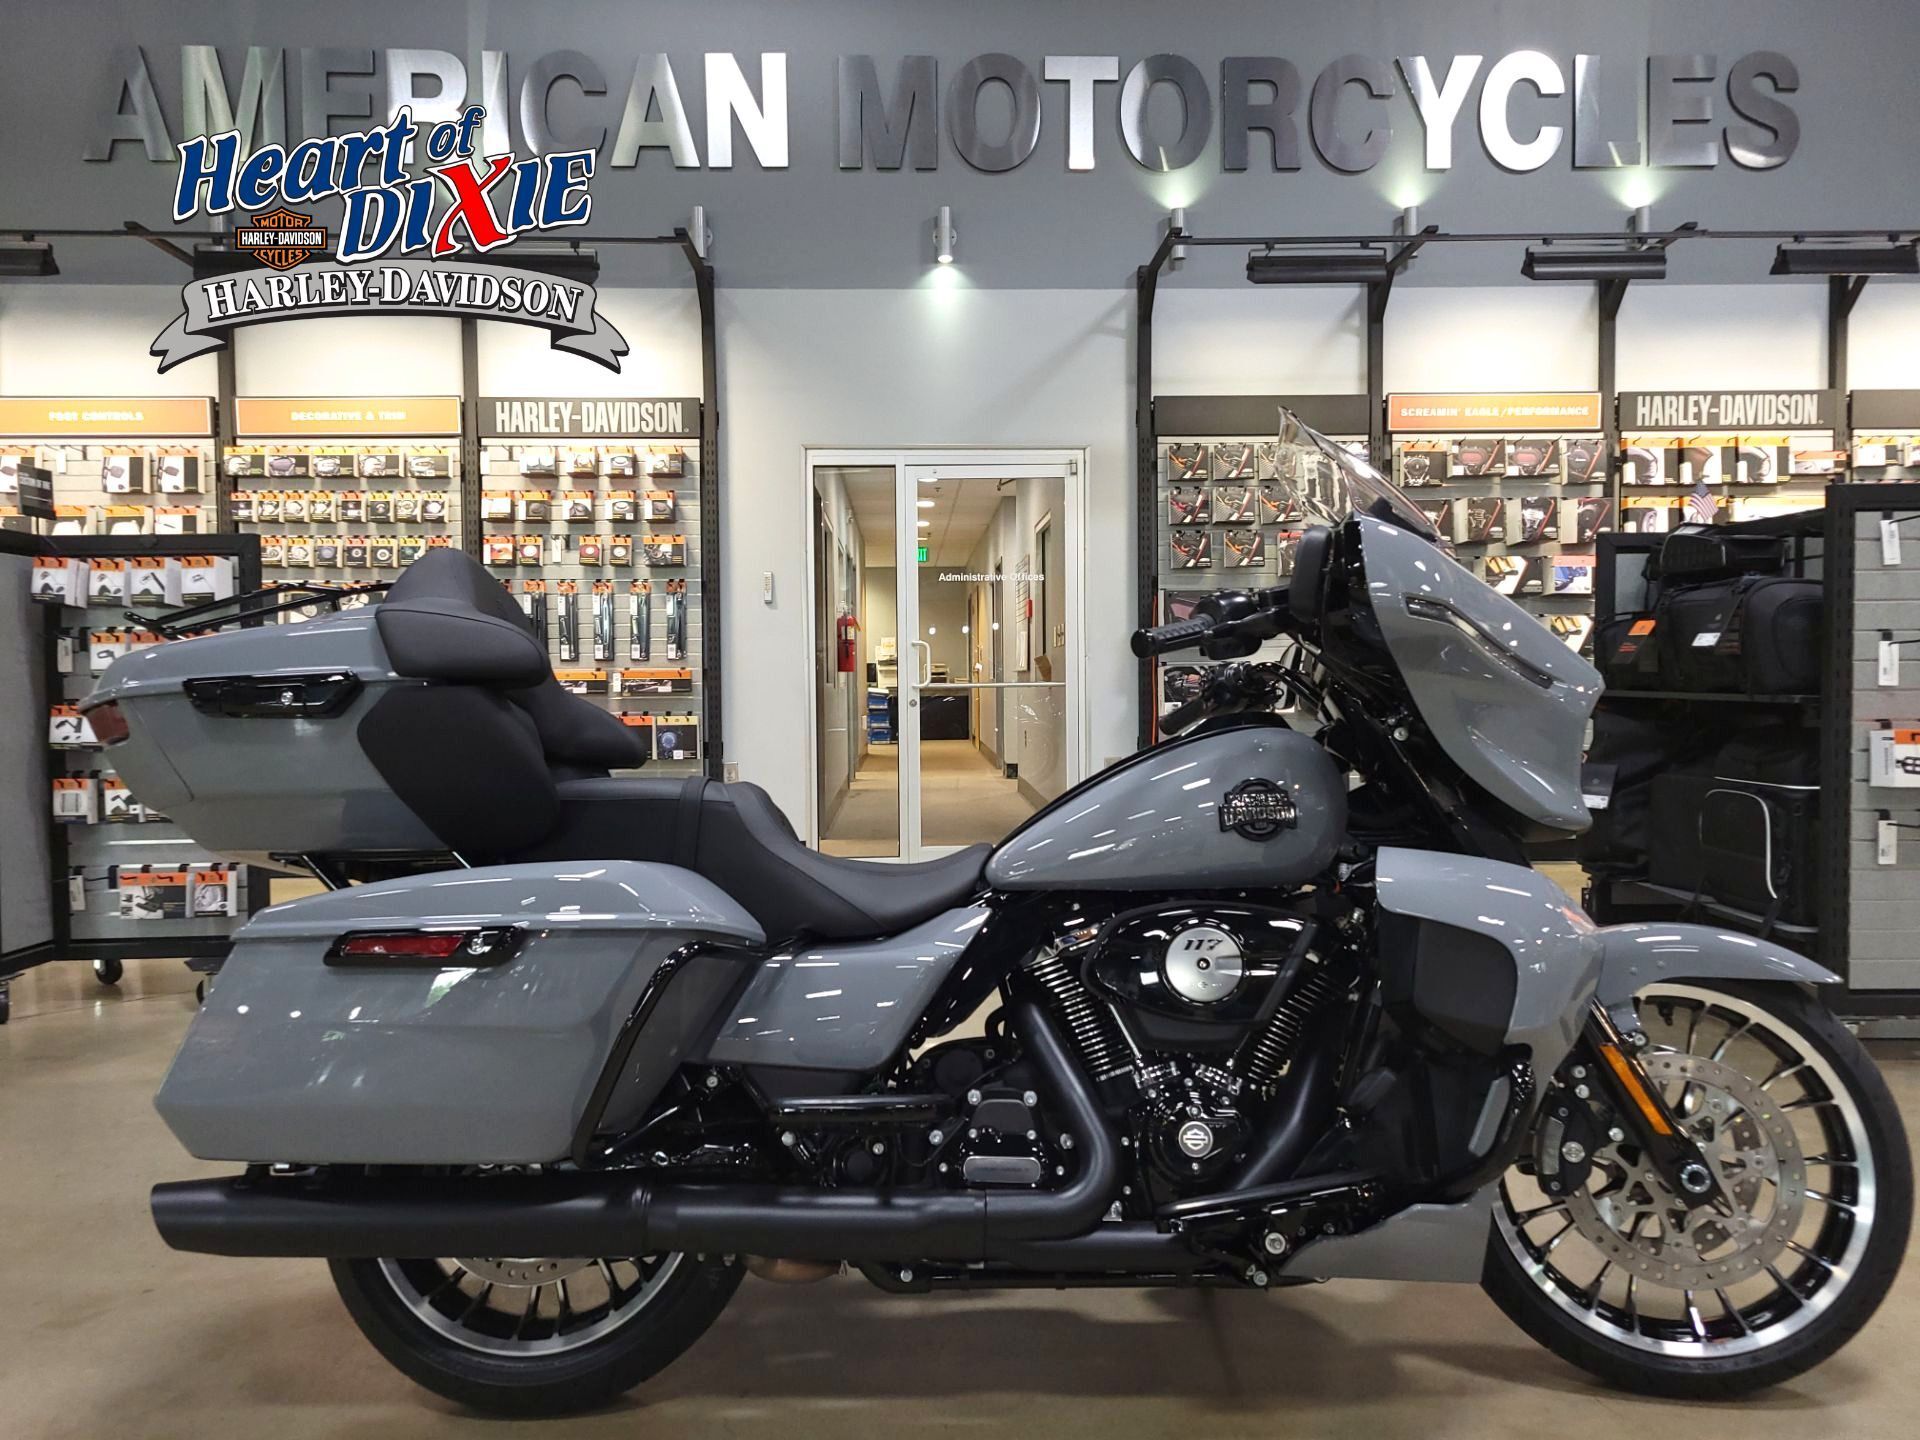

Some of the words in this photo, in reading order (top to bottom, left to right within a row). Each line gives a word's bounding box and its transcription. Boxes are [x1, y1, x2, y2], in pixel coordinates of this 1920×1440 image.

[84, 45, 789, 168] AMERICAN
[838, 51, 1800, 172] MOTORCYCLES
[495, 401, 682, 433] HARLEY-DAVIDSON
[1636, 394, 1819, 427] HARLEY-DAVIDSON
[938, 572, 1007, 582] Administrative
[1009, 572, 1045, 582] Offices
[1183, 939, 1223, 951] 117
